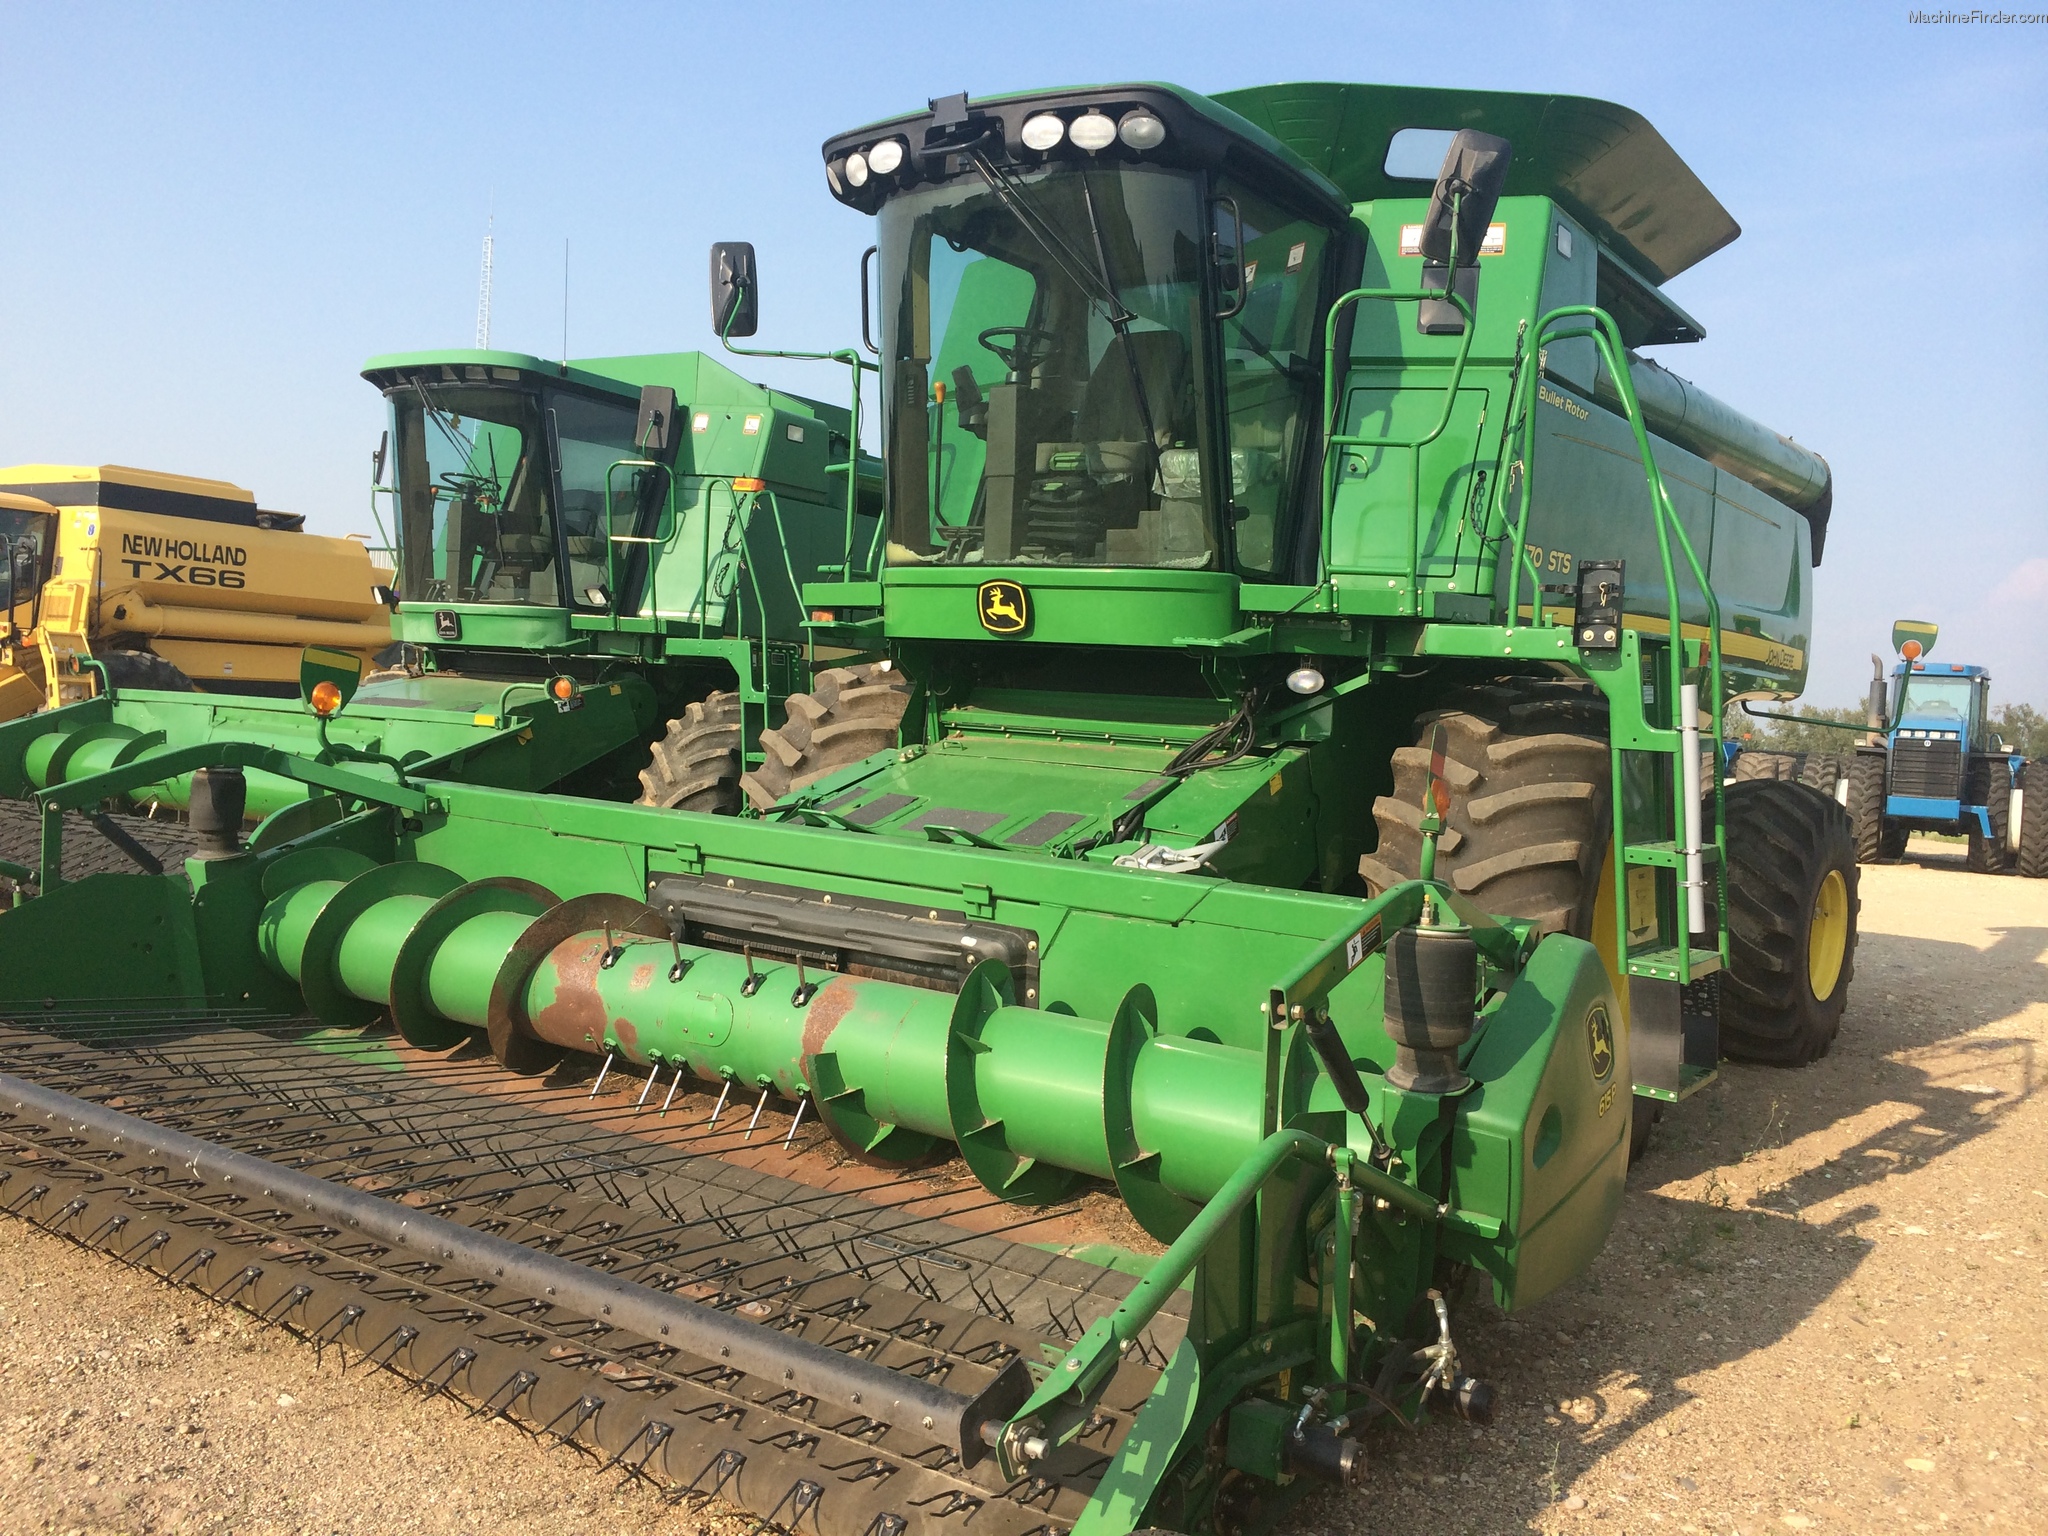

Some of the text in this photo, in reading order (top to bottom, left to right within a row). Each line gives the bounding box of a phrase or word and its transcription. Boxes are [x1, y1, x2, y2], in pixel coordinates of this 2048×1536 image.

[1538, 385, 1589, 421] Bullet Rotor
[122, 533, 247, 567] NEW HOLLAND
[1511, 543, 1572, 575] 70 STS
[121, 558, 246, 589] TX66
